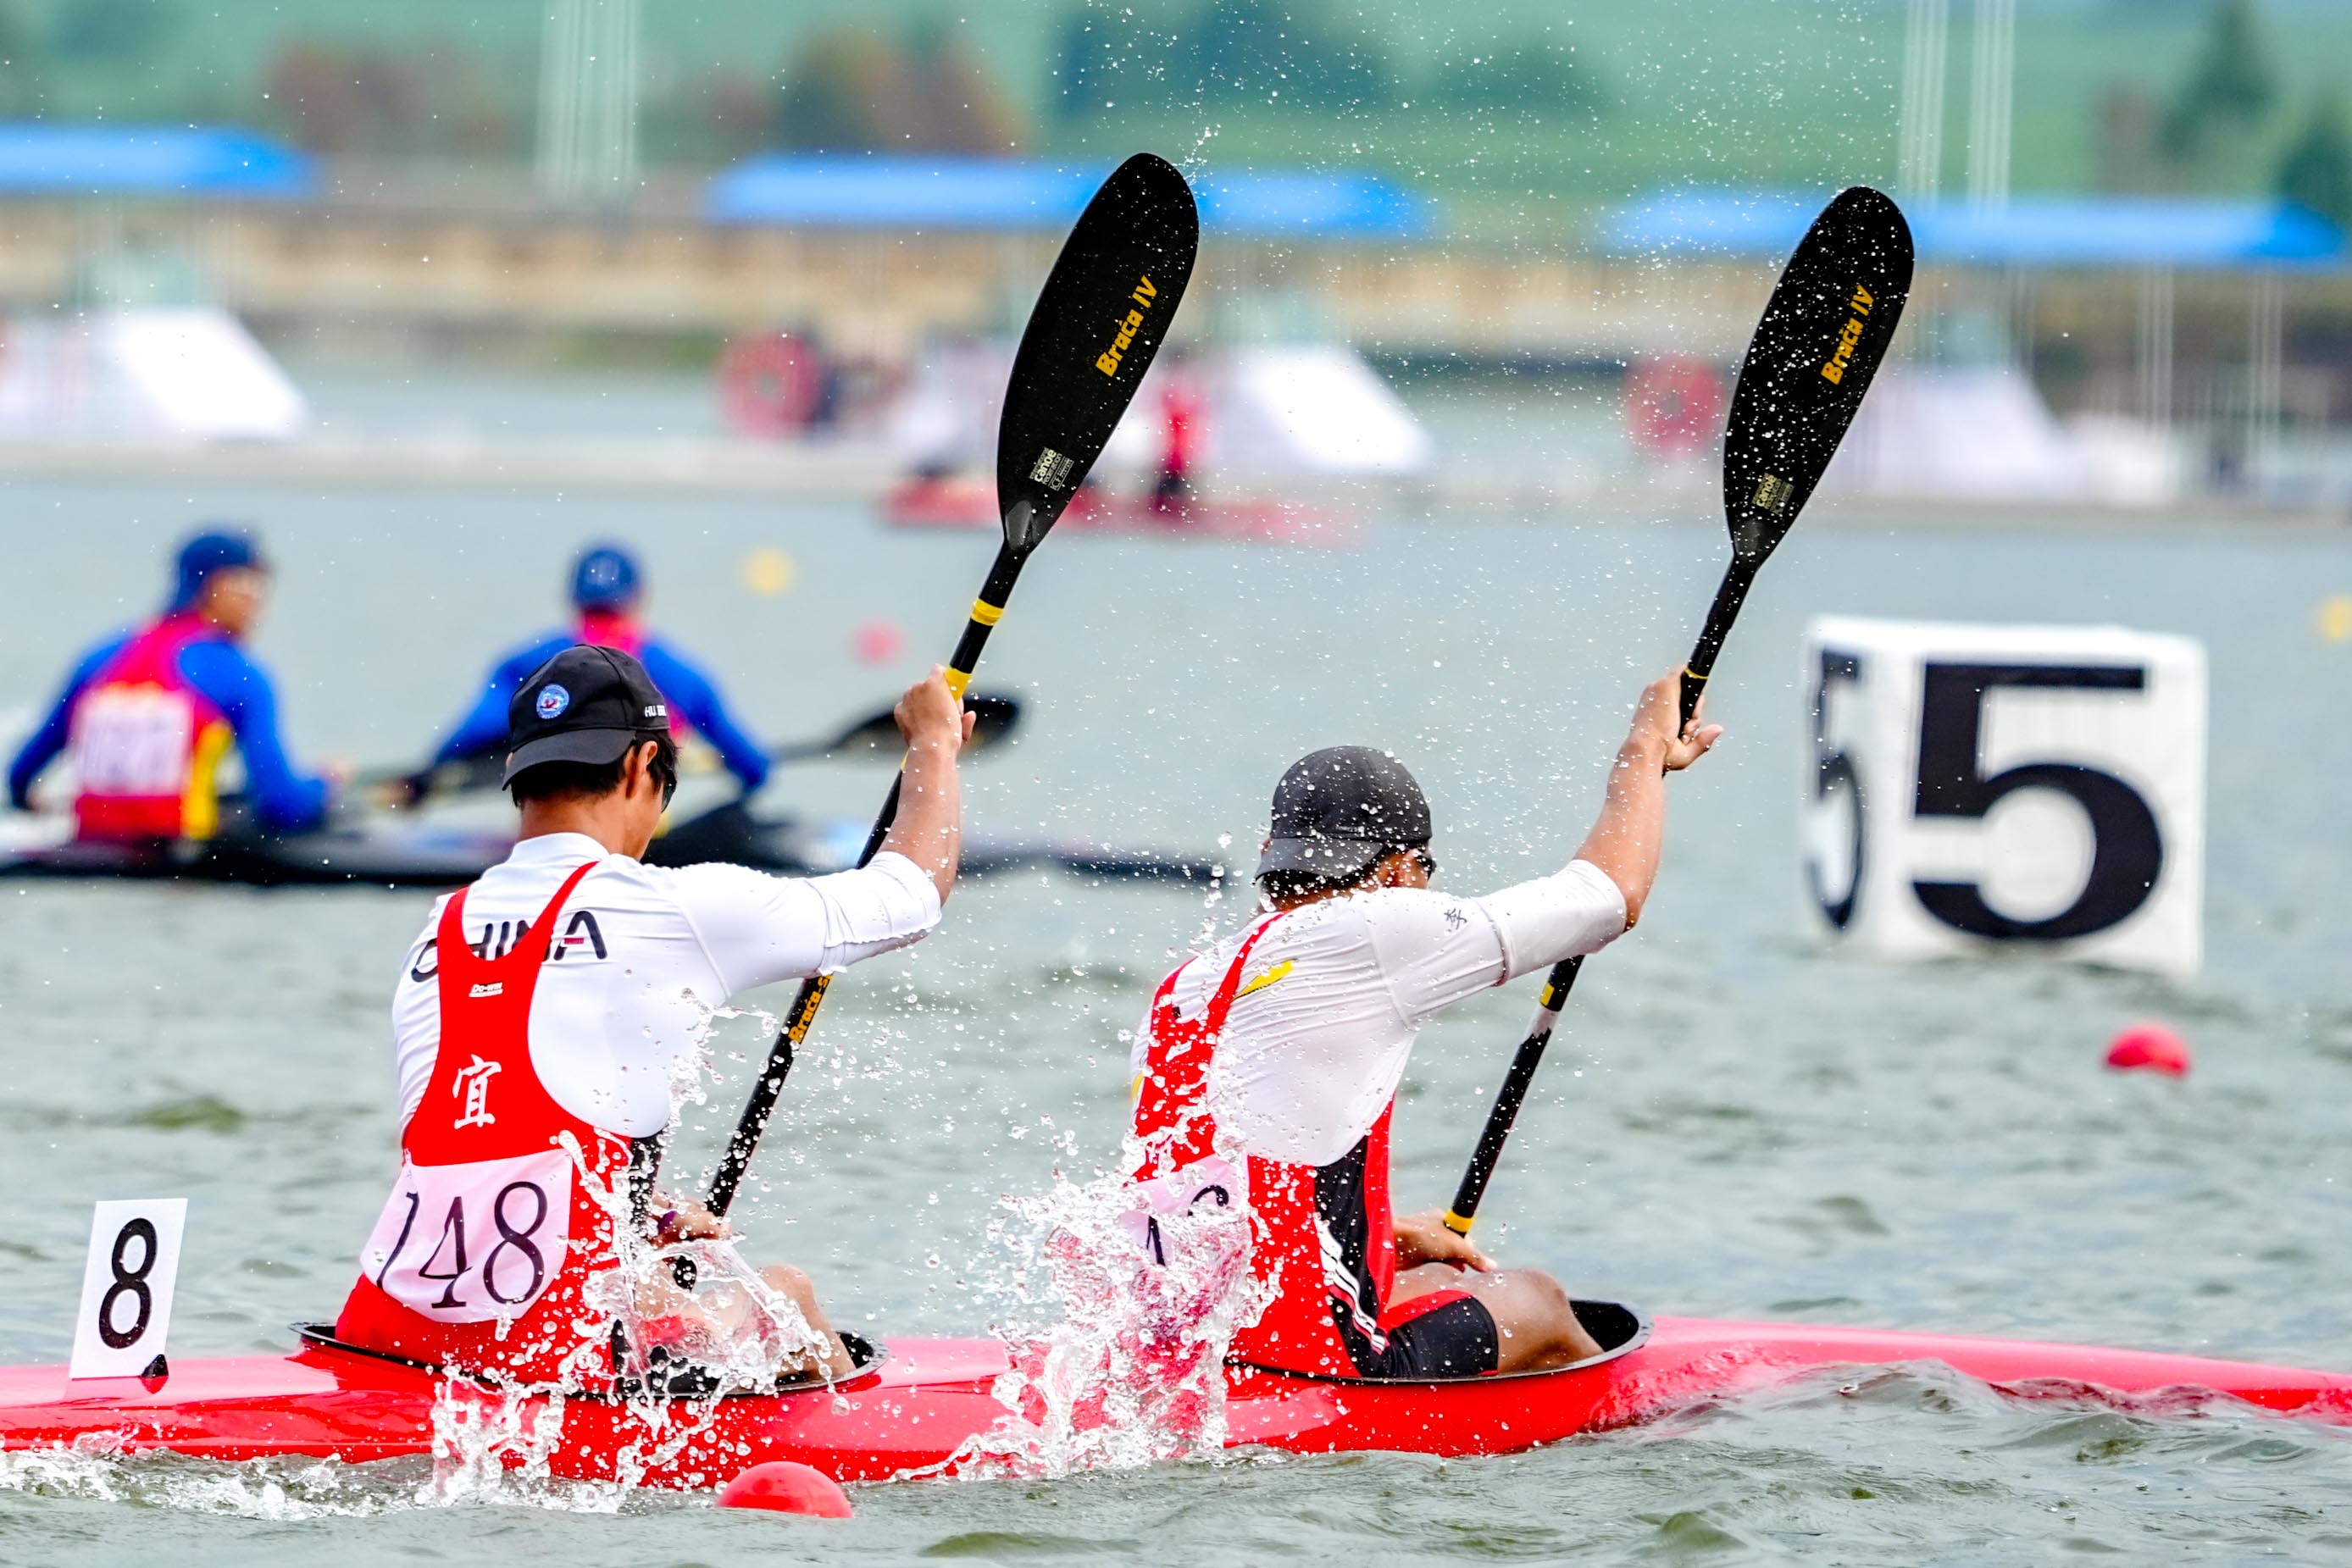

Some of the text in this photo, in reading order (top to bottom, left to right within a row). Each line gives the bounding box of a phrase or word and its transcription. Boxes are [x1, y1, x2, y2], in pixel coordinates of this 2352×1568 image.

[1132, 275, 1157, 308] IV
[1850, 285, 1874, 315] IV
[1034, 449, 1057, 482] canoe
[1911, 662, 2163, 939] 5
[452, 1054, 502, 1129] 宜
[381, 1181, 548, 1309] 148
[99, 1217, 158, 1349] 8
